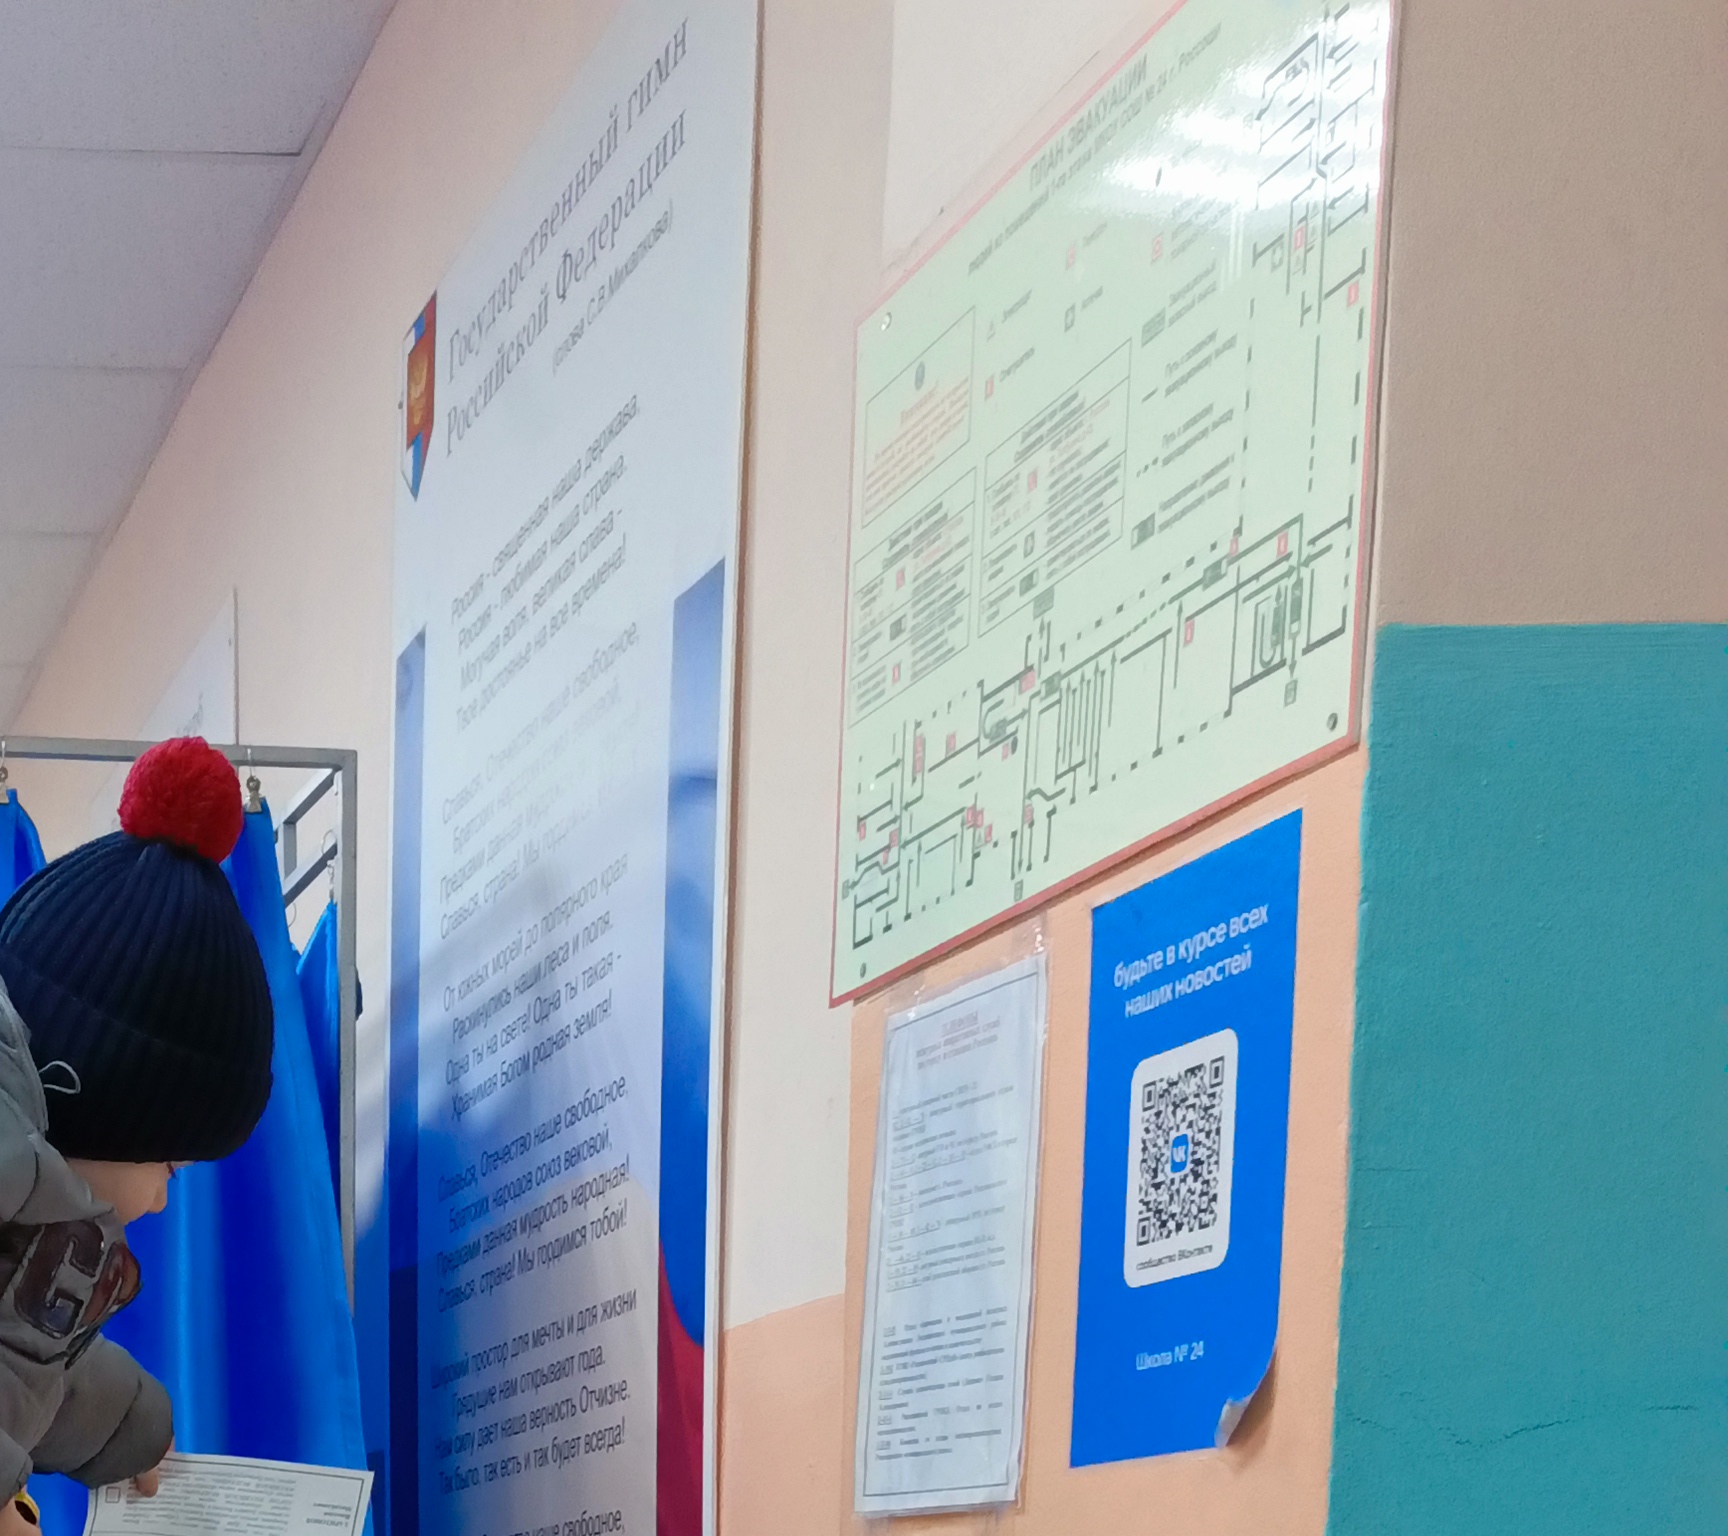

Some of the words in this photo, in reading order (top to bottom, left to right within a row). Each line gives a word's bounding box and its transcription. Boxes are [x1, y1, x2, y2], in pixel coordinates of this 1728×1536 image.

[1029, 134, 1065, 192] ПЛАН
[1067, 52, 1148, 154] ЭВАКУАЦИИ
[448, 103, 619, 384] Государственный
[625, 16, 688, 133] гимн
[446, 282, 550, 458] Российской
[556, 108, 687, 304] Федерации
[550, 503, 580, 551] наша
[551, 458, 582, 510] наша
[579, 510, 614, 563] слава
[534, 624, 547, 653] на
[572, 531, 626, 617] времена!
[443, 986, 456, 1012] От
[458, 966, 490, 1002] южных
[491, 927, 522, 975] морей
[524, 923, 539, 957] до
[540, 877, 598, 935] полярного
[599, 852, 628, 896] края
[1113, 950, 1164, 991] будьте
[1166, 944, 1175, 966] в
[1178, 922, 1228, 964] курсе
[1229, 903, 1270, 938] всех
[1124, 982, 1173, 1019] наших
[1175, 942, 1253, 999] новостей
[445, 1053, 470, 1088] Одна
[471, 1047, 484, 1069] ты
[485, 1039, 498, 1060] на
[500, 1003, 531, 1048] свете!
[533, 988, 561, 1026] Одна
[564, 977, 579, 1004] ты
[581, 951, 614, 992] такая
[452, 986, 512, 1045] Раскинулись
[513, 962, 541, 999] наши
[542, 941, 570, 981] леса
[572, 936, 579, 958] и
[451, 1073, 498, 1123] Хранимая
[500, 1050, 531, 1088] Богом
[531, 1023, 571, 1074] родная
[573, 988, 612, 1041] земля!
[448, 1198, 490, 1235] Братских
[492, 1171, 533, 1214] народов
[534, 1156, 562, 1187] союз
[564, 1121, 612, 1171] вековой,
[480, 1131, 532, 1178] Отечество
[533, 1112, 562, 1145] наше
[564, 1075, 628, 1129] свободное,
[436, 1240, 481, 1279] Предками
[482, 1219, 518, 1259] данная
[519, 1191, 569, 1239] мудрость
[570, 1152, 630, 1210] народная!
[479, 1253, 515, 1296] страна!
[517, 1246, 535, 1276] Мы
[537, 1225, 587, 1270] гордимся
[589, 1196, 628, 1242] тобой!
[431, 1351, 470, 1391] Широкий
[471, 1341, 509, 1377] простор
[510, 1332, 530, 1360] для
[531, 1318, 565, 1350] мечты
[566, 1315, 574, 1335] и
[576, 1304, 598, 1337] для
[600, 1287, 637, 1323] жизни
[452, 1386, 496, 1421] Грядущие
[498, 1377, 518, 1401] нам
[520, 1354, 575, 1395] открывают
[577, 1344, 606, 1376] года.
[1135, 1351, 1172, 1371] Школа
[1190, 1340, 1204, 1361] 24
[438, 1470, 454, 1495] Так
[483, 1462, 499, 1482] так
[500, 1457, 522, 1478] есть
[523, 1451, 531, 1471] и
[532, 1446, 550, 1469] так
[551, 1435, 582, 1470] будет
[583, 1415, 625, 1454] всегда!
[454, 1431, 476, 1457] силу
[500, 1413, 527, 1438] наша
[529, 1395, 577, 1433] верность
[578, 1379, 630, 1414] Отчизне.
